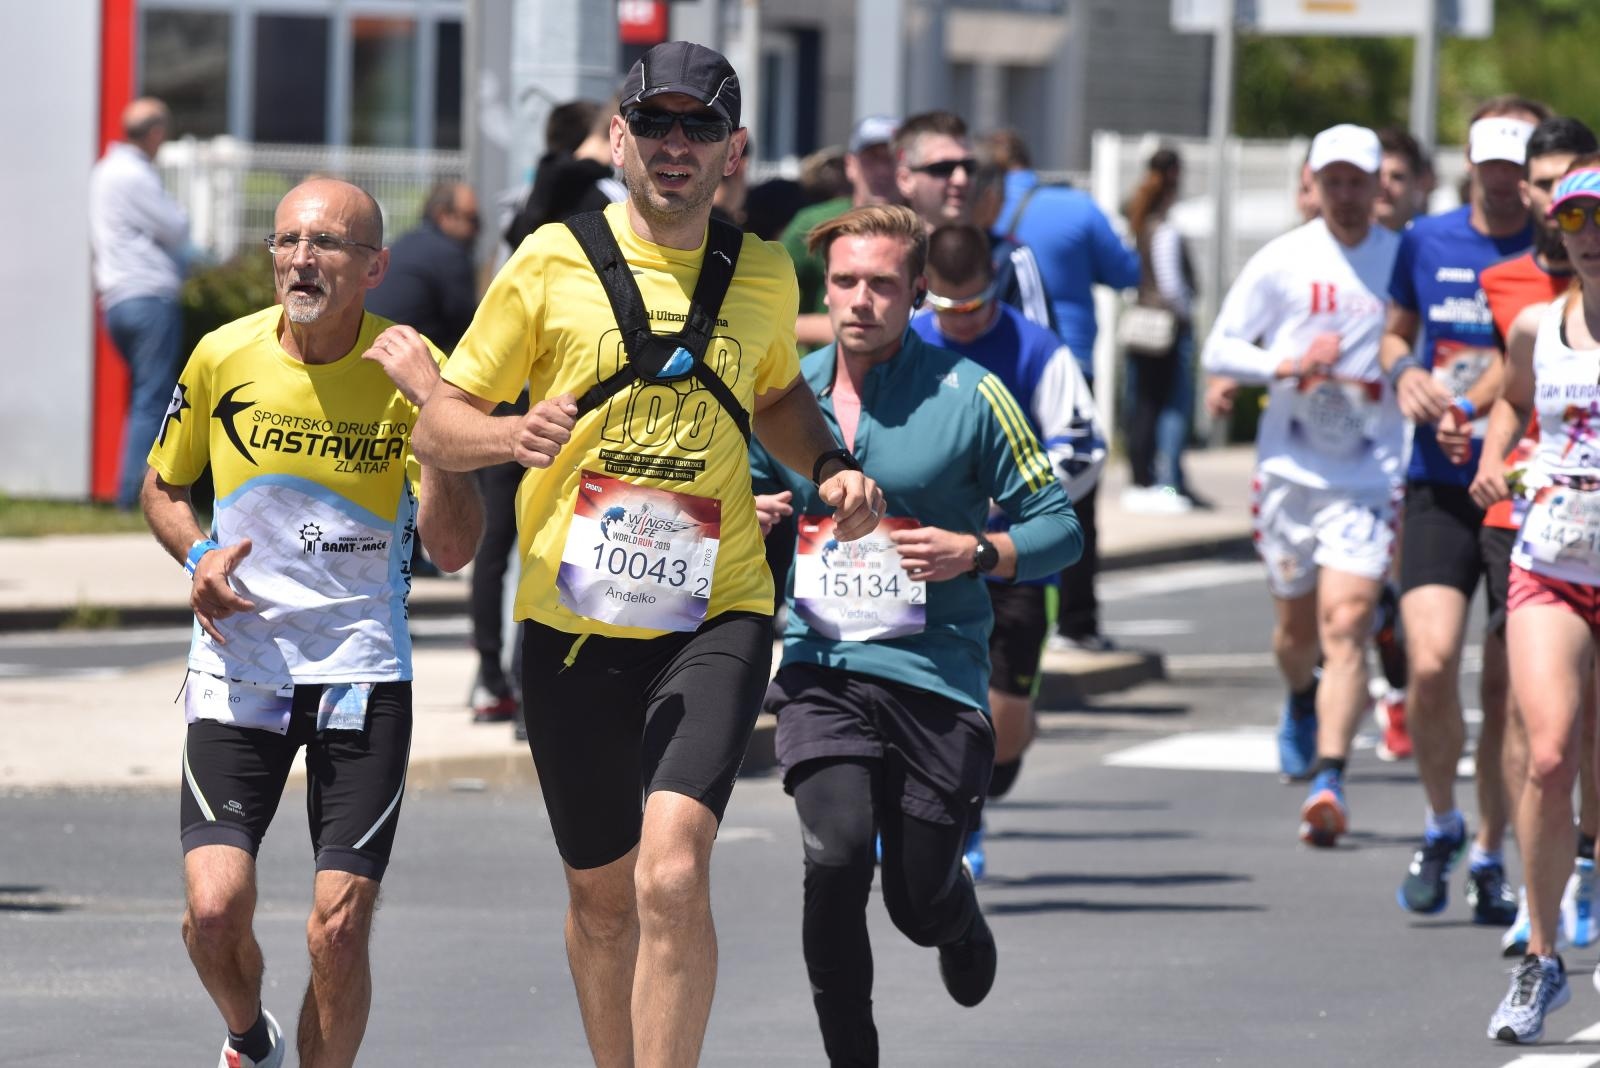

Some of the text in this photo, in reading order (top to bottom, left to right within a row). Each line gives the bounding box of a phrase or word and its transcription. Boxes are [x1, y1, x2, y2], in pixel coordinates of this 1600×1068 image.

[252, 410, 408, 436] SPORTSKO DRUŠTVO
[601, 383, 721, 452] 100
[250, 425, 405, 461] LASTAVICA
[334, 460, 390, 474] ZLATAR
[585, 482, 602, 493] CROATIA
[628, 512, 674, 531] WINGS
[631, 525, 659, 538] LIFE
[654, 540, 671, 551] 2019
[593, 542, 688, 587] 10043
[605, 586, 657, 604] Anđelko
[694, 577, 709, 597] 2
[819, 573, 922, 602] 15134 2
[840, 607, 879, 620] Vedran
